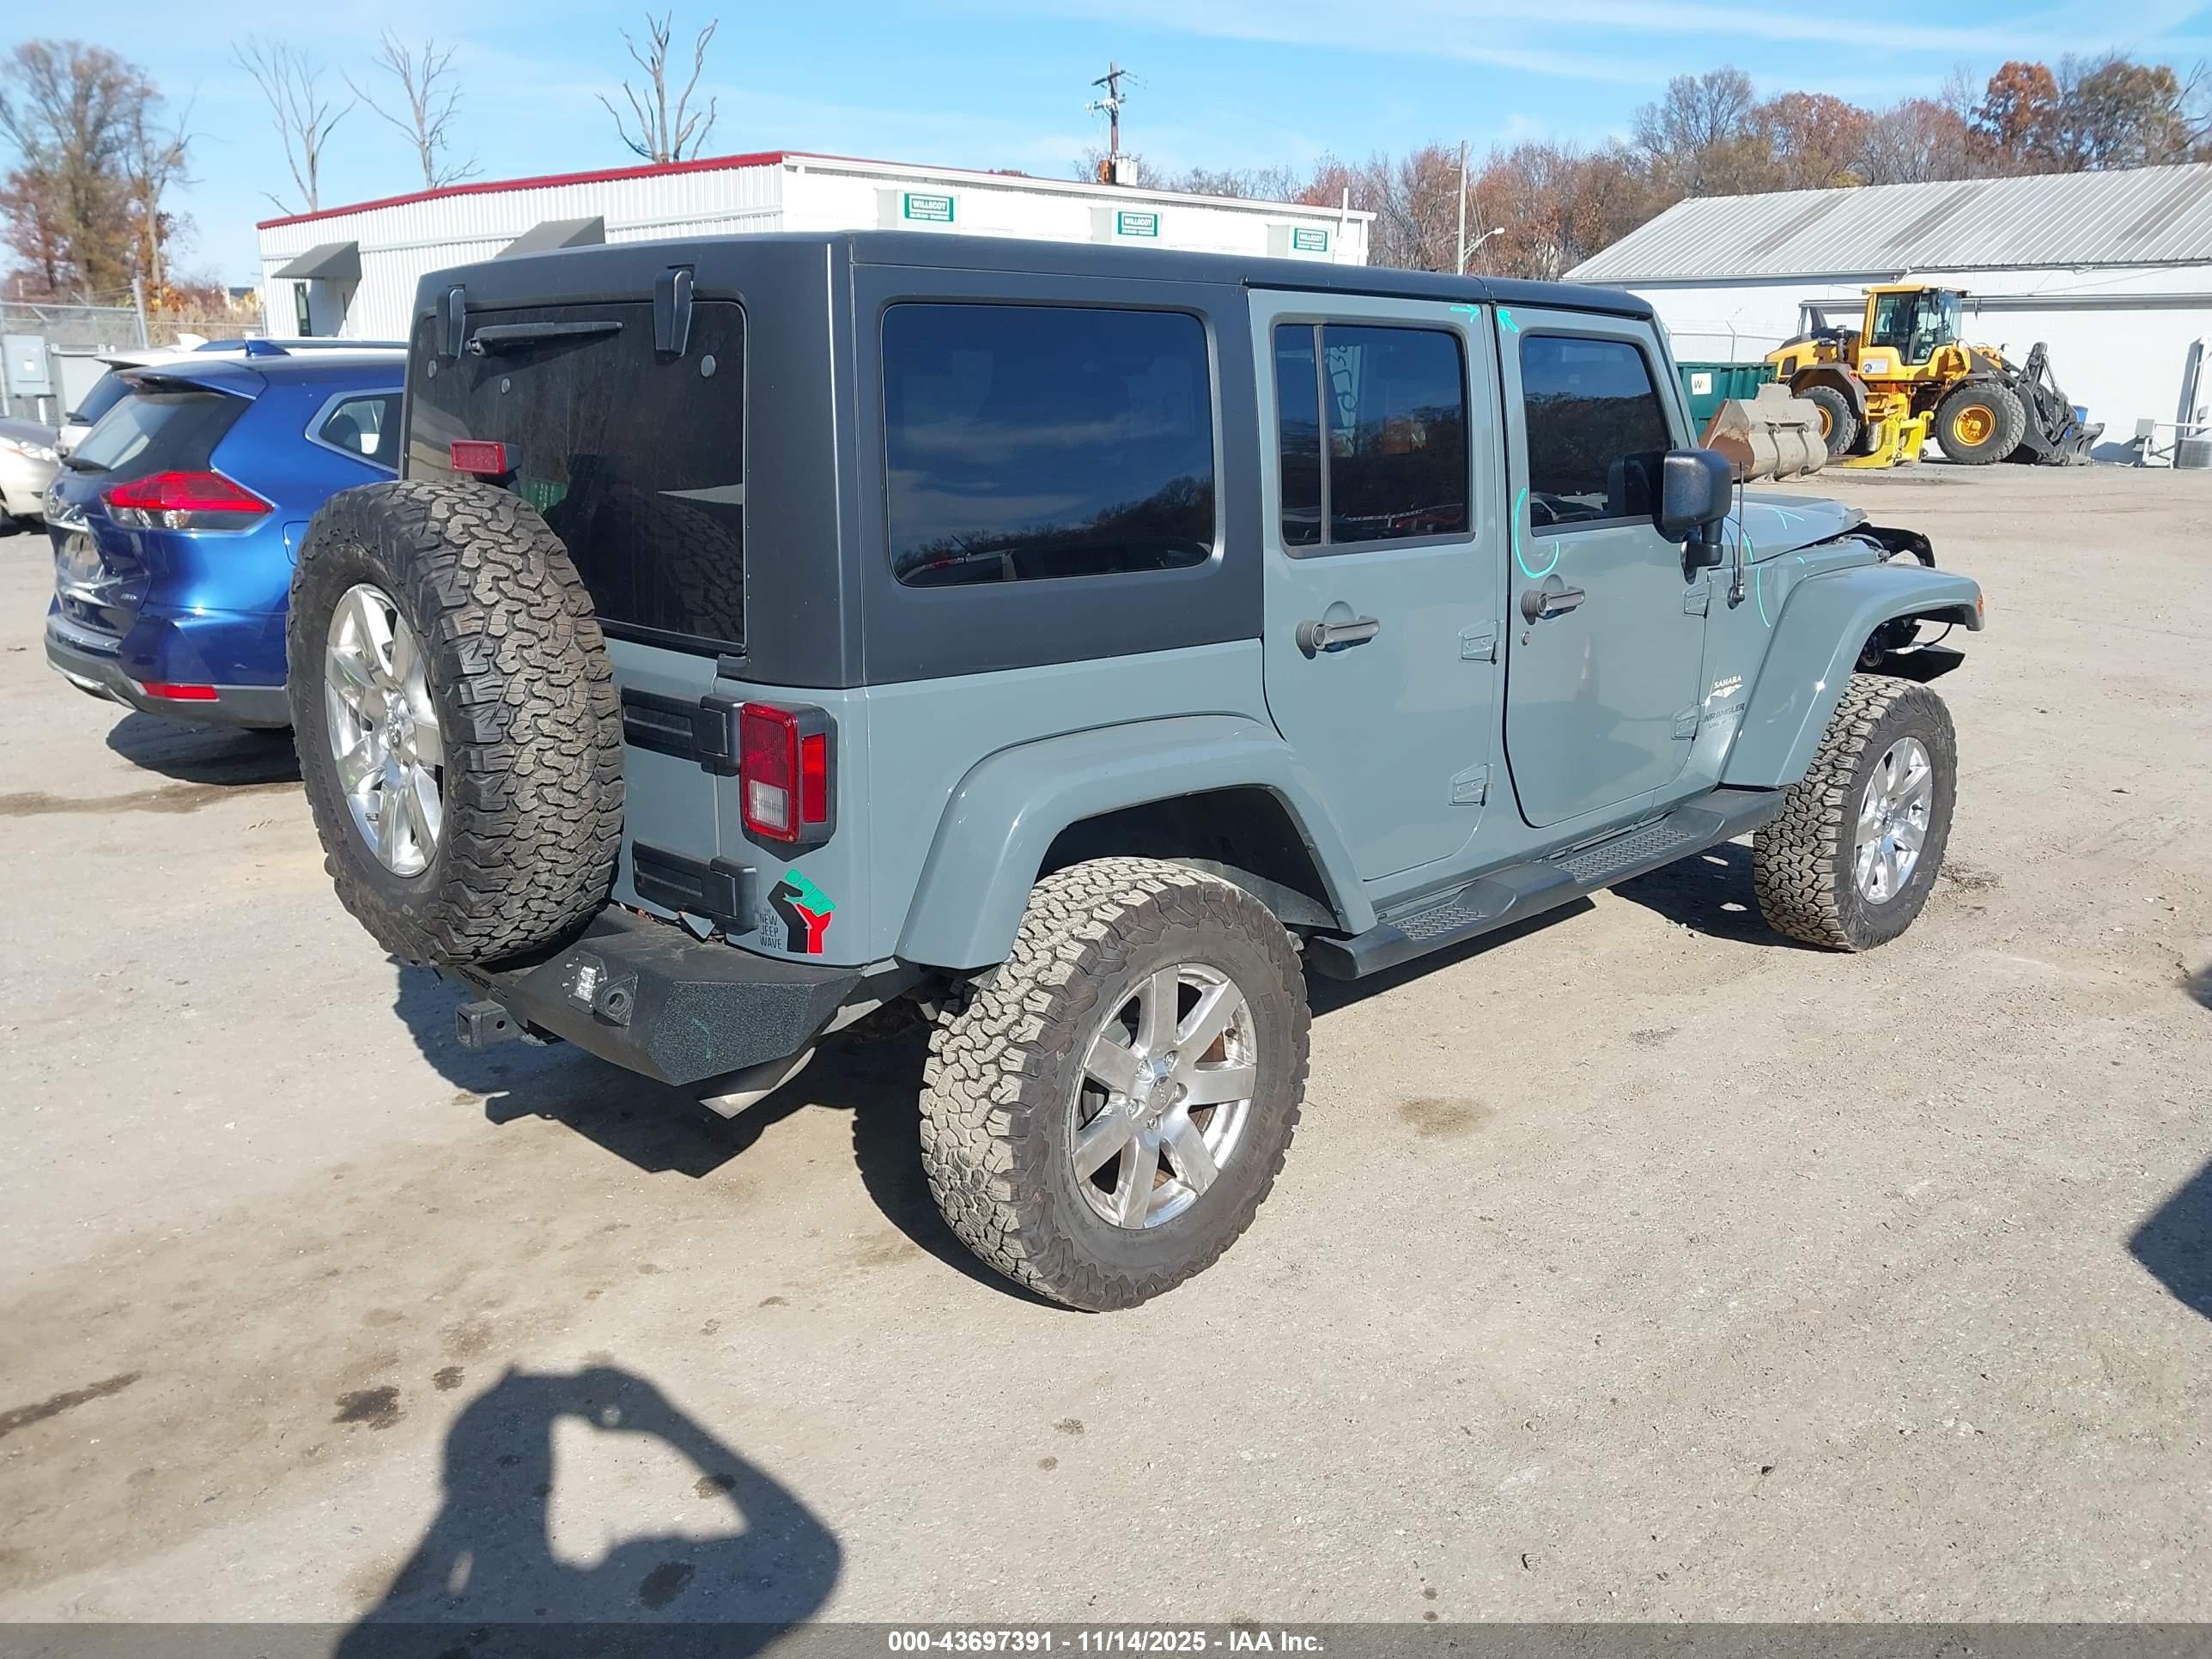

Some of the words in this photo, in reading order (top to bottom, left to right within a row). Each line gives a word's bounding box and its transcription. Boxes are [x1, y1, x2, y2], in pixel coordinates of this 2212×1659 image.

[1714, 674, 1742, 688] SAHARA
[760, 913, 778, 926] NEW
[761, 925, 779, 937] JEEP
[759, 935, 782, 949] WAVE
